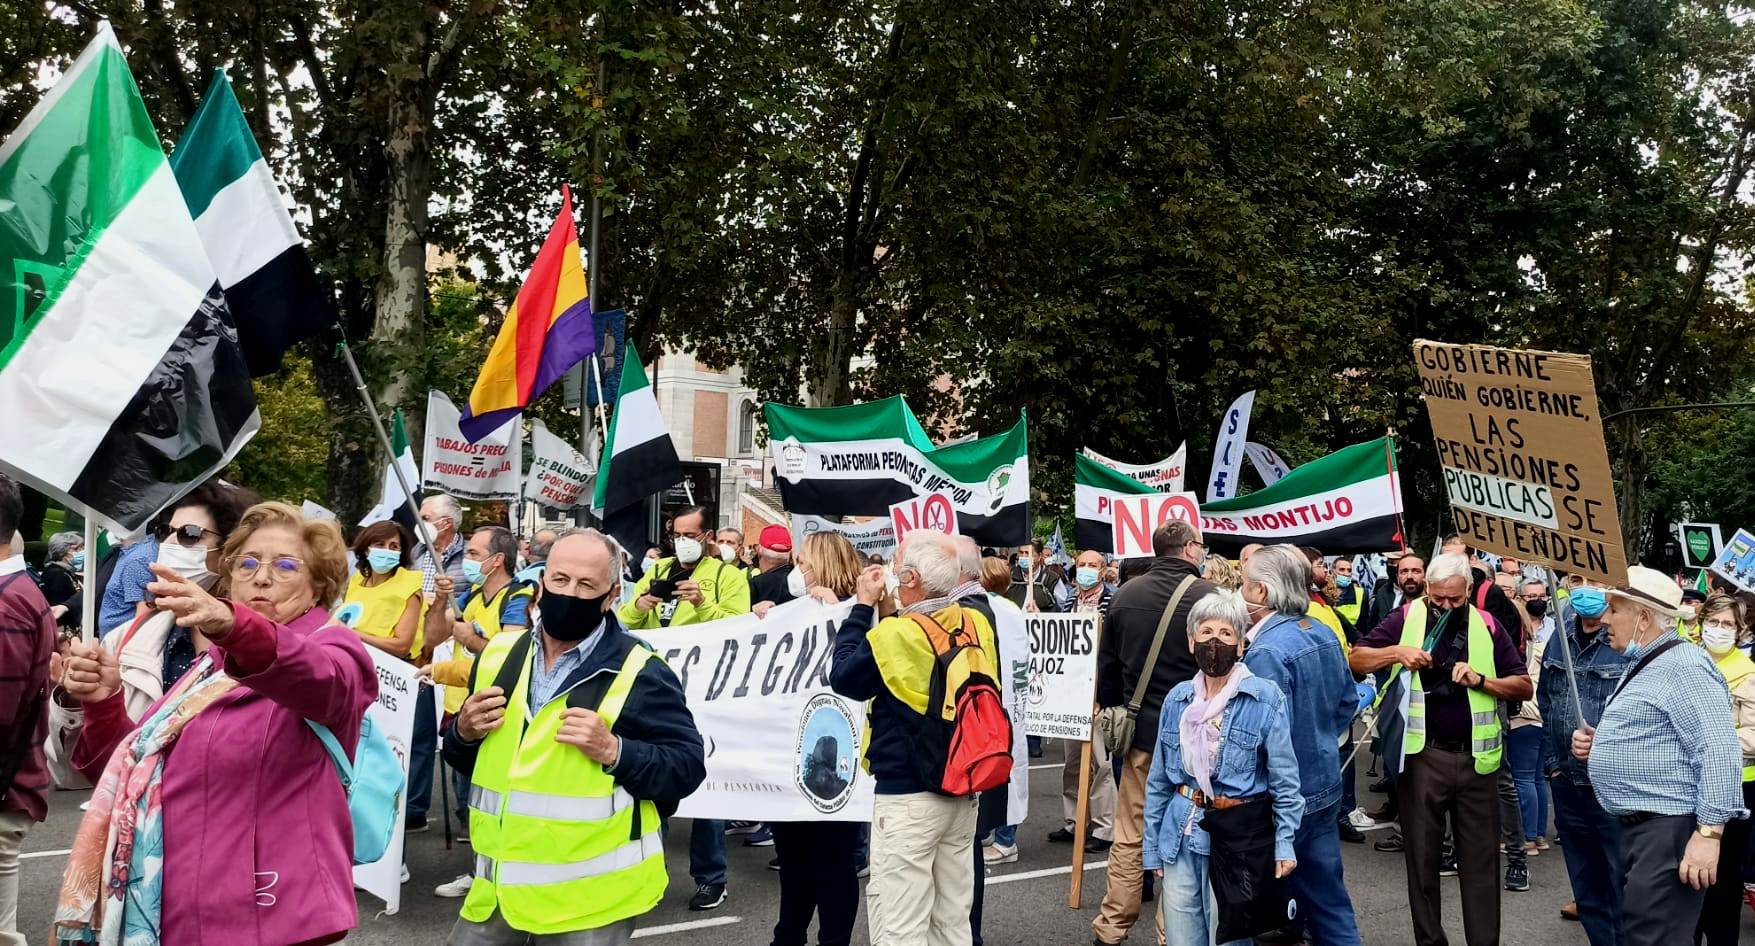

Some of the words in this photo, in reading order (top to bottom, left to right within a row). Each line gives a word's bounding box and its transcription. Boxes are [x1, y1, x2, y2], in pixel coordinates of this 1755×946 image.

[1421, 345, 1551, 381] GOBIERNE
[1422, 374, 1467, 401] QUIÉN
[1477, 384, 1590, 422] GOBIERNE,
[1469, 413, 1524, 448] LAS
[536, 457, 549, 467] SE
[820, 453, 880, 472] PLATAFORMA
[1437, 437, 1580, 492] PENSIONES
[892, 493, 955, 544] NO
[1242, 496, 1353, 531] MONTIJO
[1444, 468, 1553, 519] PÚBLICAS
[1563, 495, 1605, 535] SE
[1114, 496, 1199, 555] NO
[1453, 506, 1608, 574] DEFIENDEN
[1026, 619, 1094, 655] SIONES
[1028, 657, 1065, 675] AJOZ
[1042, 712, 1054, 721] POR
[1062, 714, 1092, 725] DEFENSA
[1048, 725, 1081, 737] PENSIONES
